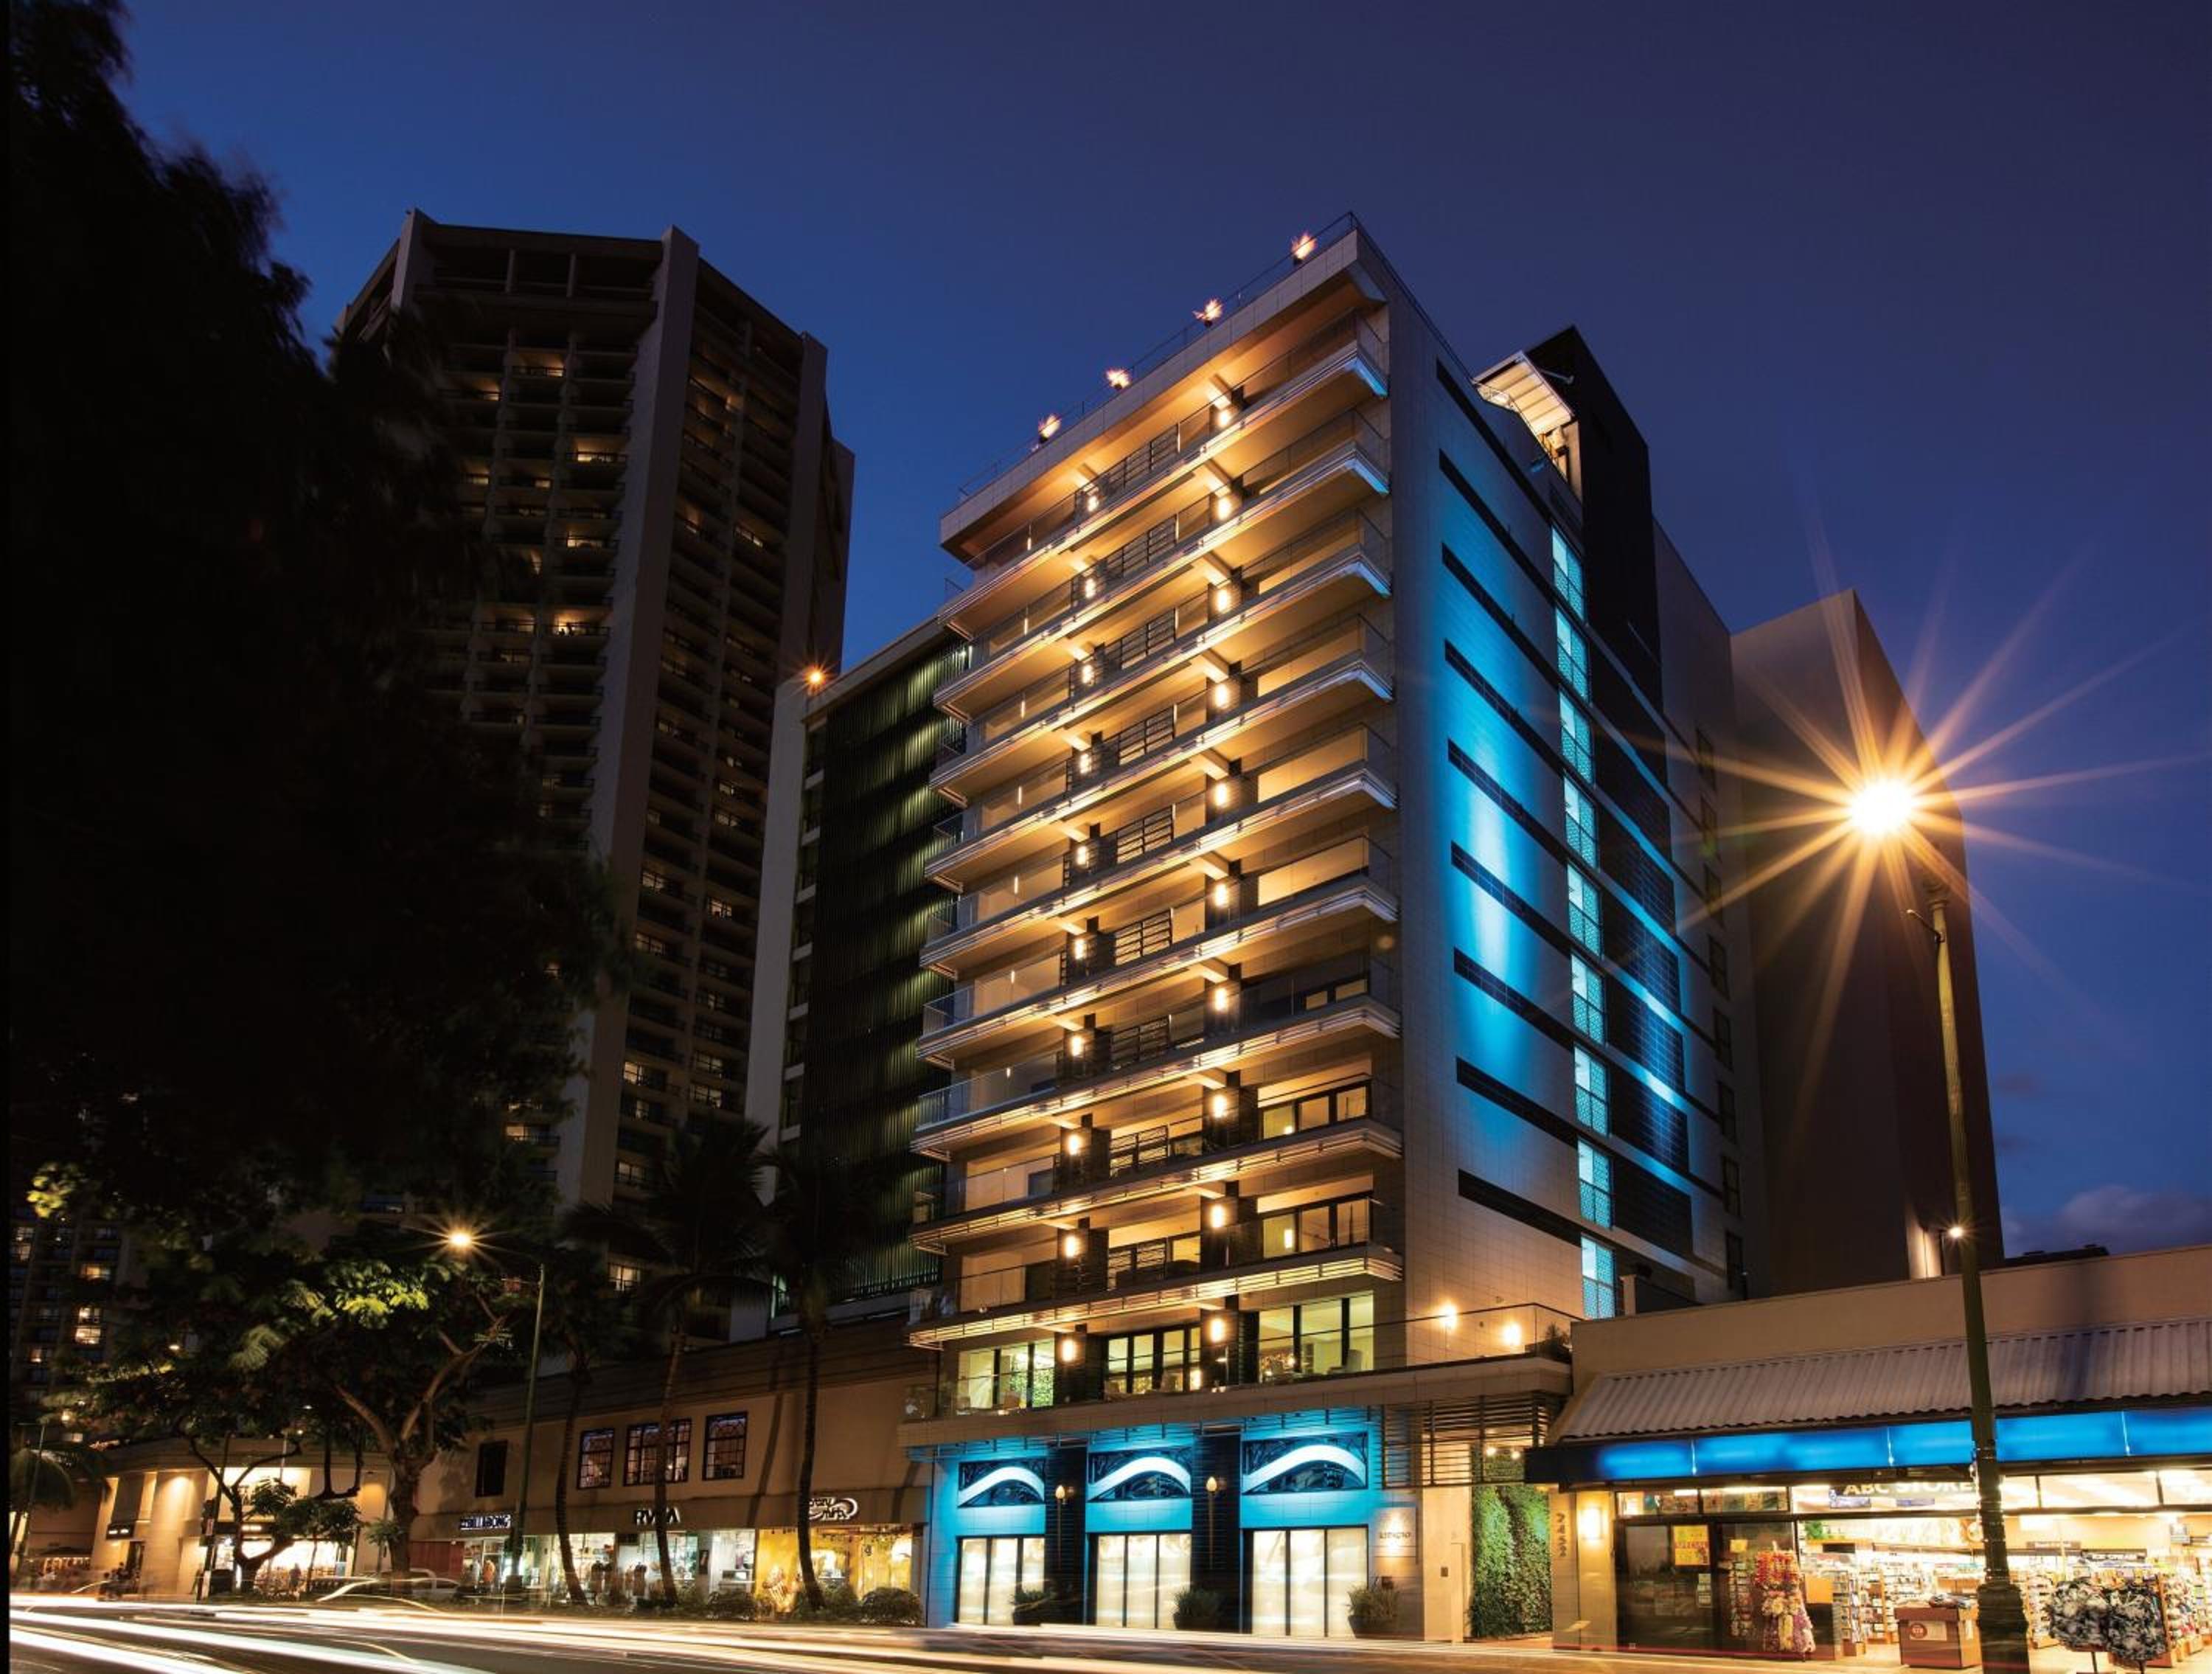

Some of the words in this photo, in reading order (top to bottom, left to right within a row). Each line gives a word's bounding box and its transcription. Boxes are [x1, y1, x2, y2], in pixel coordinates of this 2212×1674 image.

[1843, 1484, 1890, 1495] ABC
[1894, 1482, 1975, 1493] STORE
[633, 1507, 681, 1526] RVA
